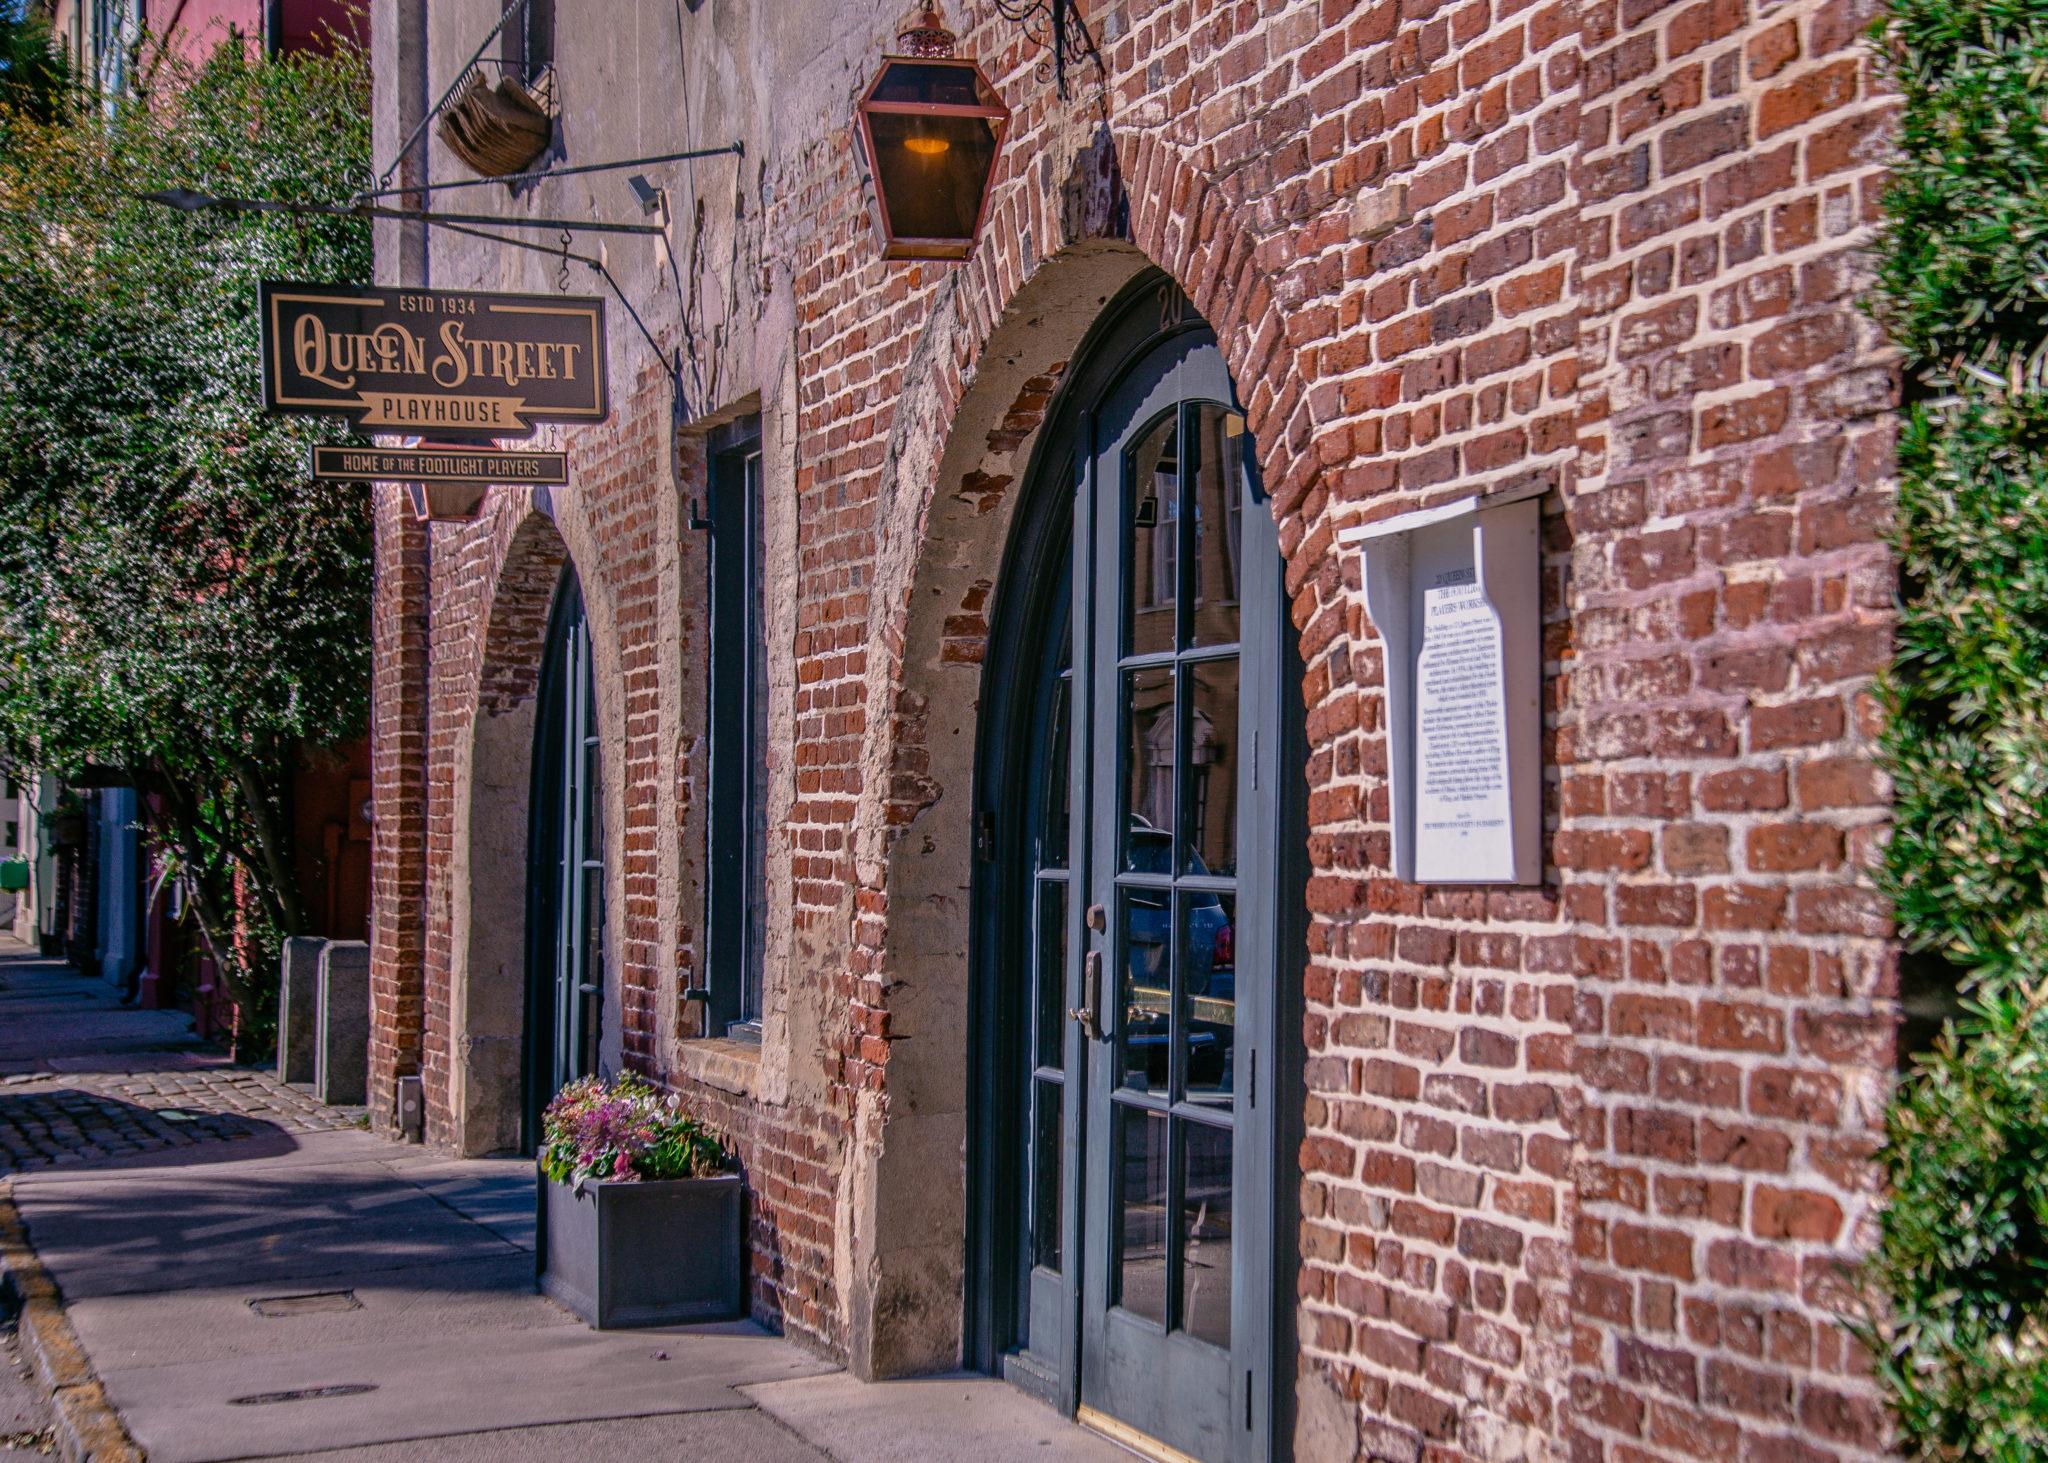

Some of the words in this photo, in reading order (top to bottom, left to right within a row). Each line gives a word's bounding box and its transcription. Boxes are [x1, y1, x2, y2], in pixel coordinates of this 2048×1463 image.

[399, 294, 435, 314] ESTD
[441, 297, 476, 316] 1934
[293, 312, 427, 390] QUEEN
[431, 320, 581, 388] STREET
[382, 398, 502, 423] PLAYHOUSE
[343, 454, 379, 472] HOME
[382, 457, 395, 471] OF
[397, 458, 416, 472] THE
[418, 456, 483, 475] FOOTLIGHT
[487, 458, 540, 476] PLAYERS
